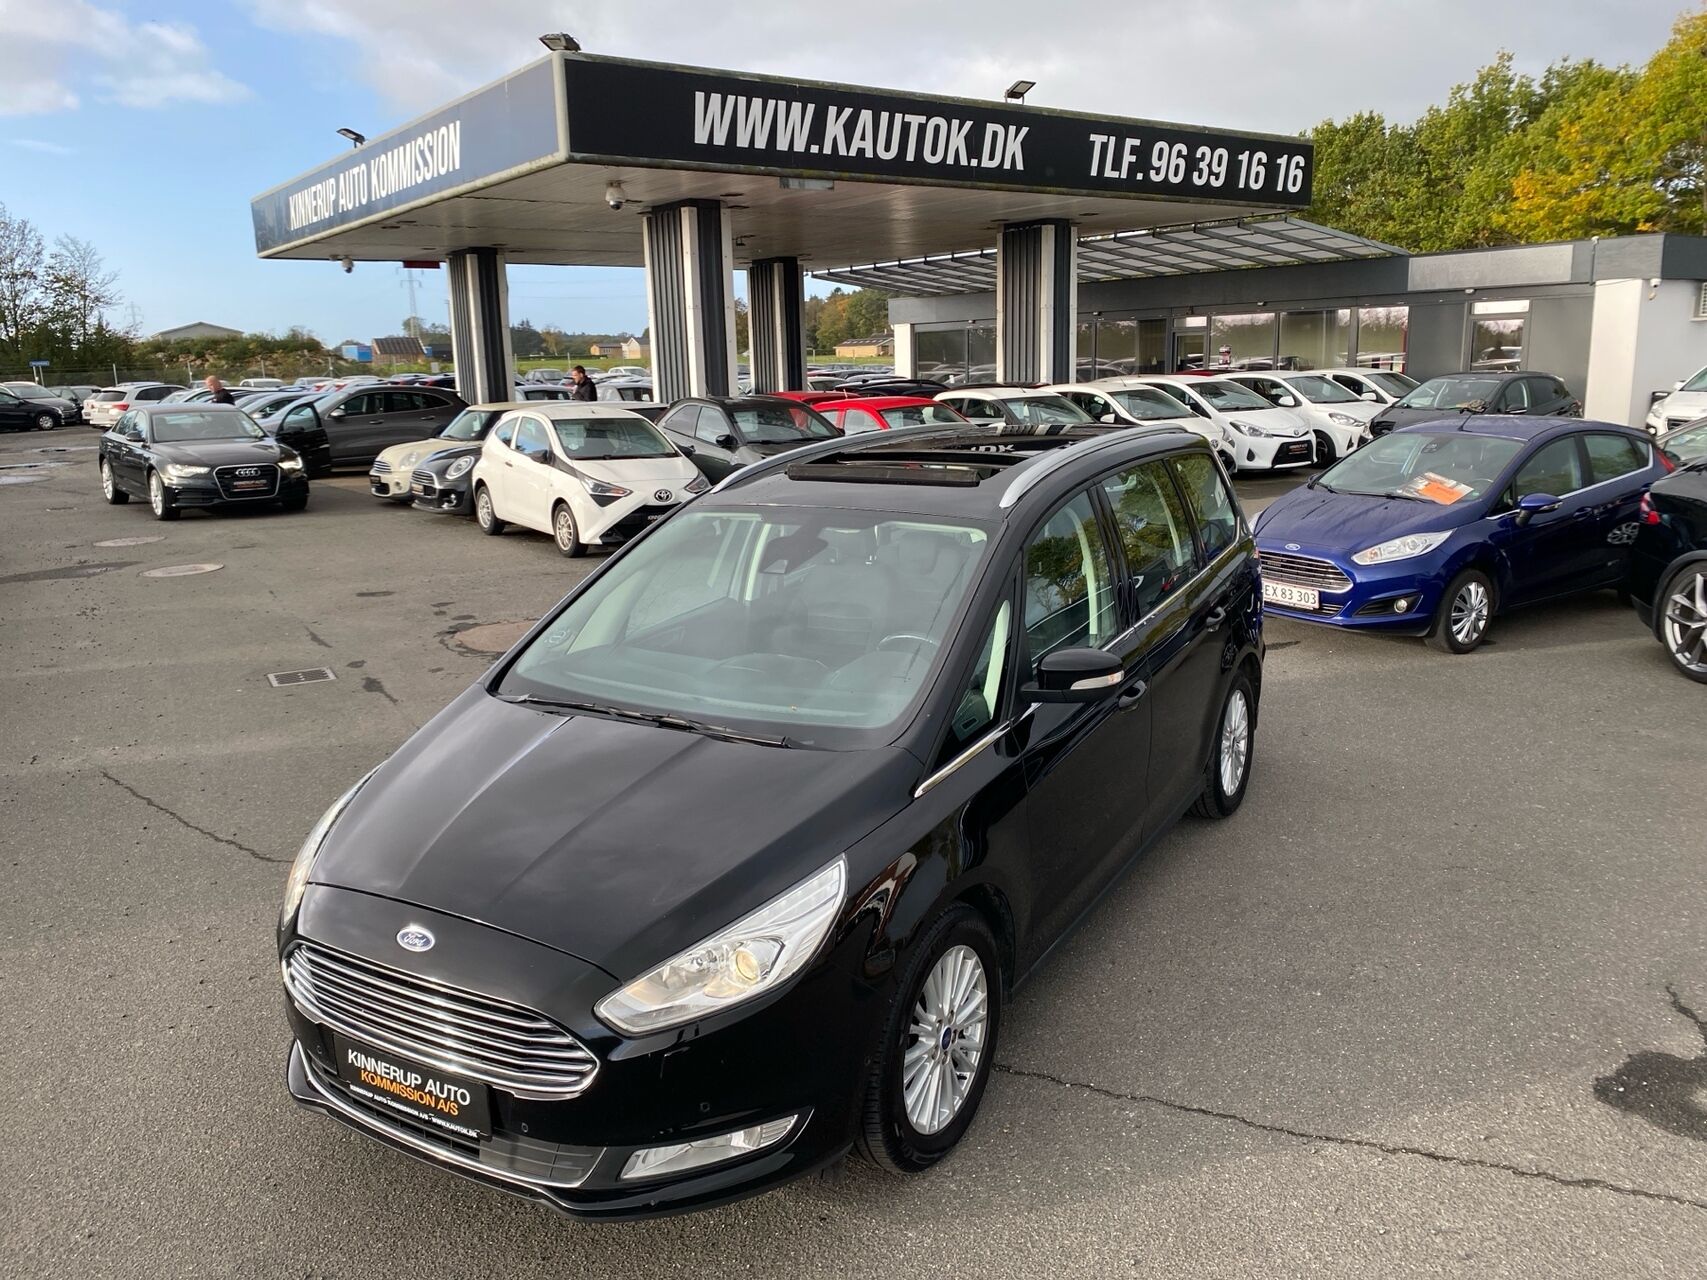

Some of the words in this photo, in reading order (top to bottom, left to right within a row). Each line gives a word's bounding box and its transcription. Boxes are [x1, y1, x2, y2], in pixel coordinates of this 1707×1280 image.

[694, 91, 1030, 171] WWW.KAUTOK.DK
[289, 178, 336, 231] KINNERUP
[338, 163, 368, 213] AUTO
[371, 120, 461, 201] KOMMISSION
[1089, 133, 1144, 181] TLF.
[1150, 141, 1188, 184] 96
[1192, 145, 1229, 188] 39
[1238, 150, 1268, 190] 16
[1276, 154, 1305, 193] 16
[1264, 584, 1278, 598] EX
[1280, 587, 1294, 601] 83
[1296, 590, 1317, 605] 303
[348, 1049, 422, 1088] KINNERUP
[425, 1079, 471, 1106] AUTO
[360, 1070, 436, 1108] KOMMISSION
[437, 1098, 459, 1116] A/S
